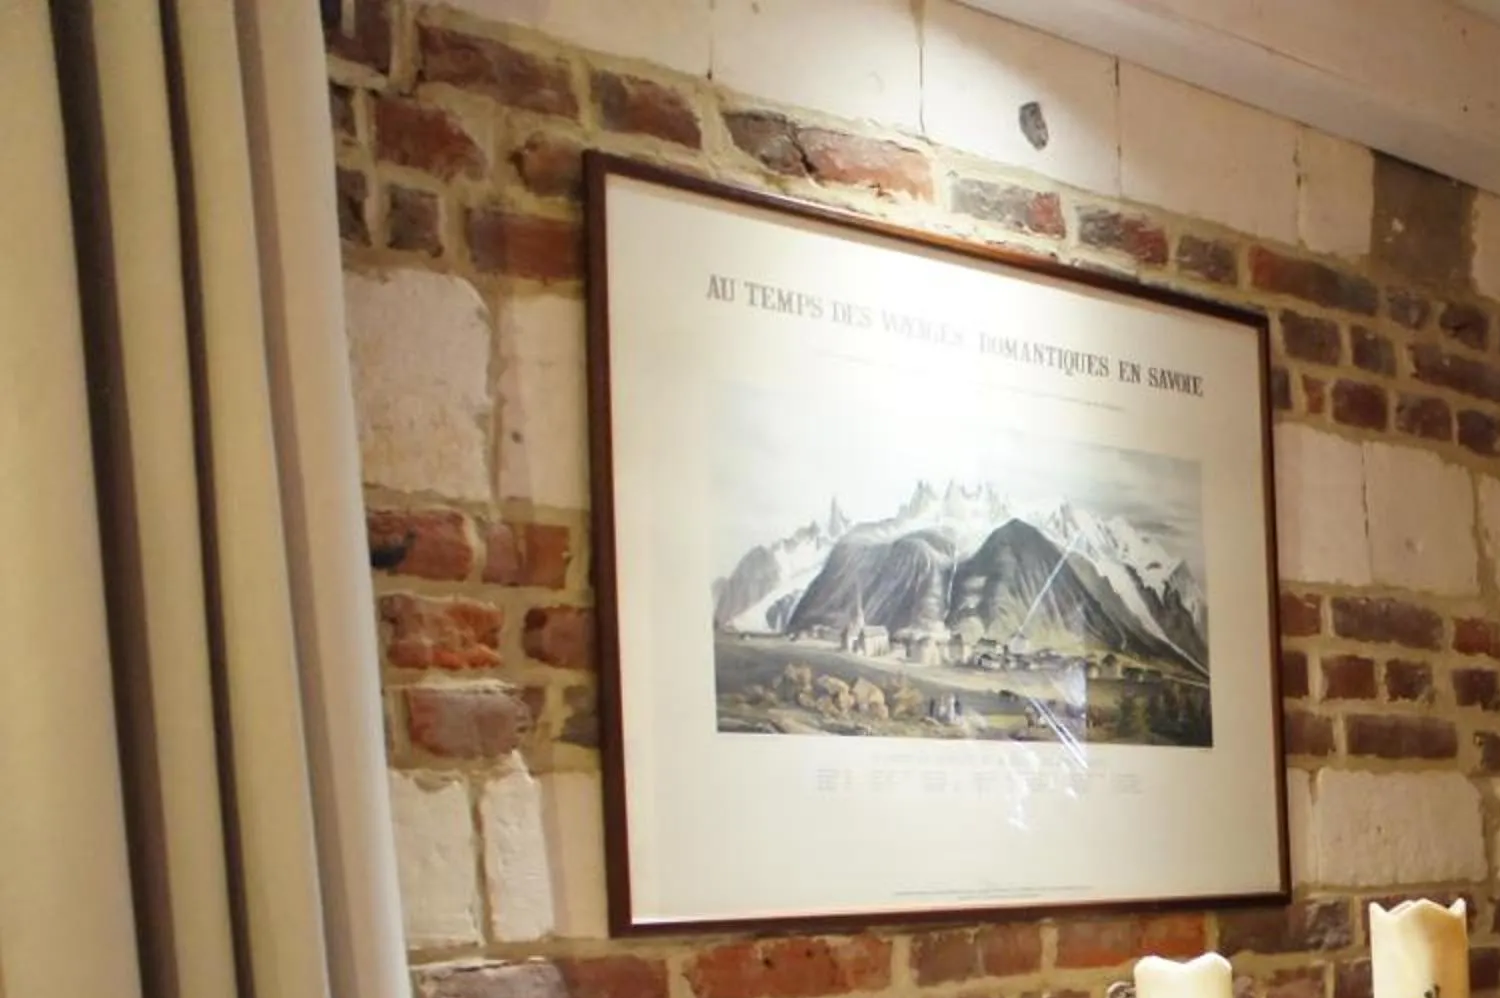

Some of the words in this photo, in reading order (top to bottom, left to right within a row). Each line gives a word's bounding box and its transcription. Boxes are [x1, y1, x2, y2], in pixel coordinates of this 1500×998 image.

[706, 273, 735, 302] AU
[743, 279, 825, 319] TEMPS
[832, 300, 874, 329] DES
[1118, 358, 1142, 385] EN
[1148, 366, 1204, 398] SAVOIE
